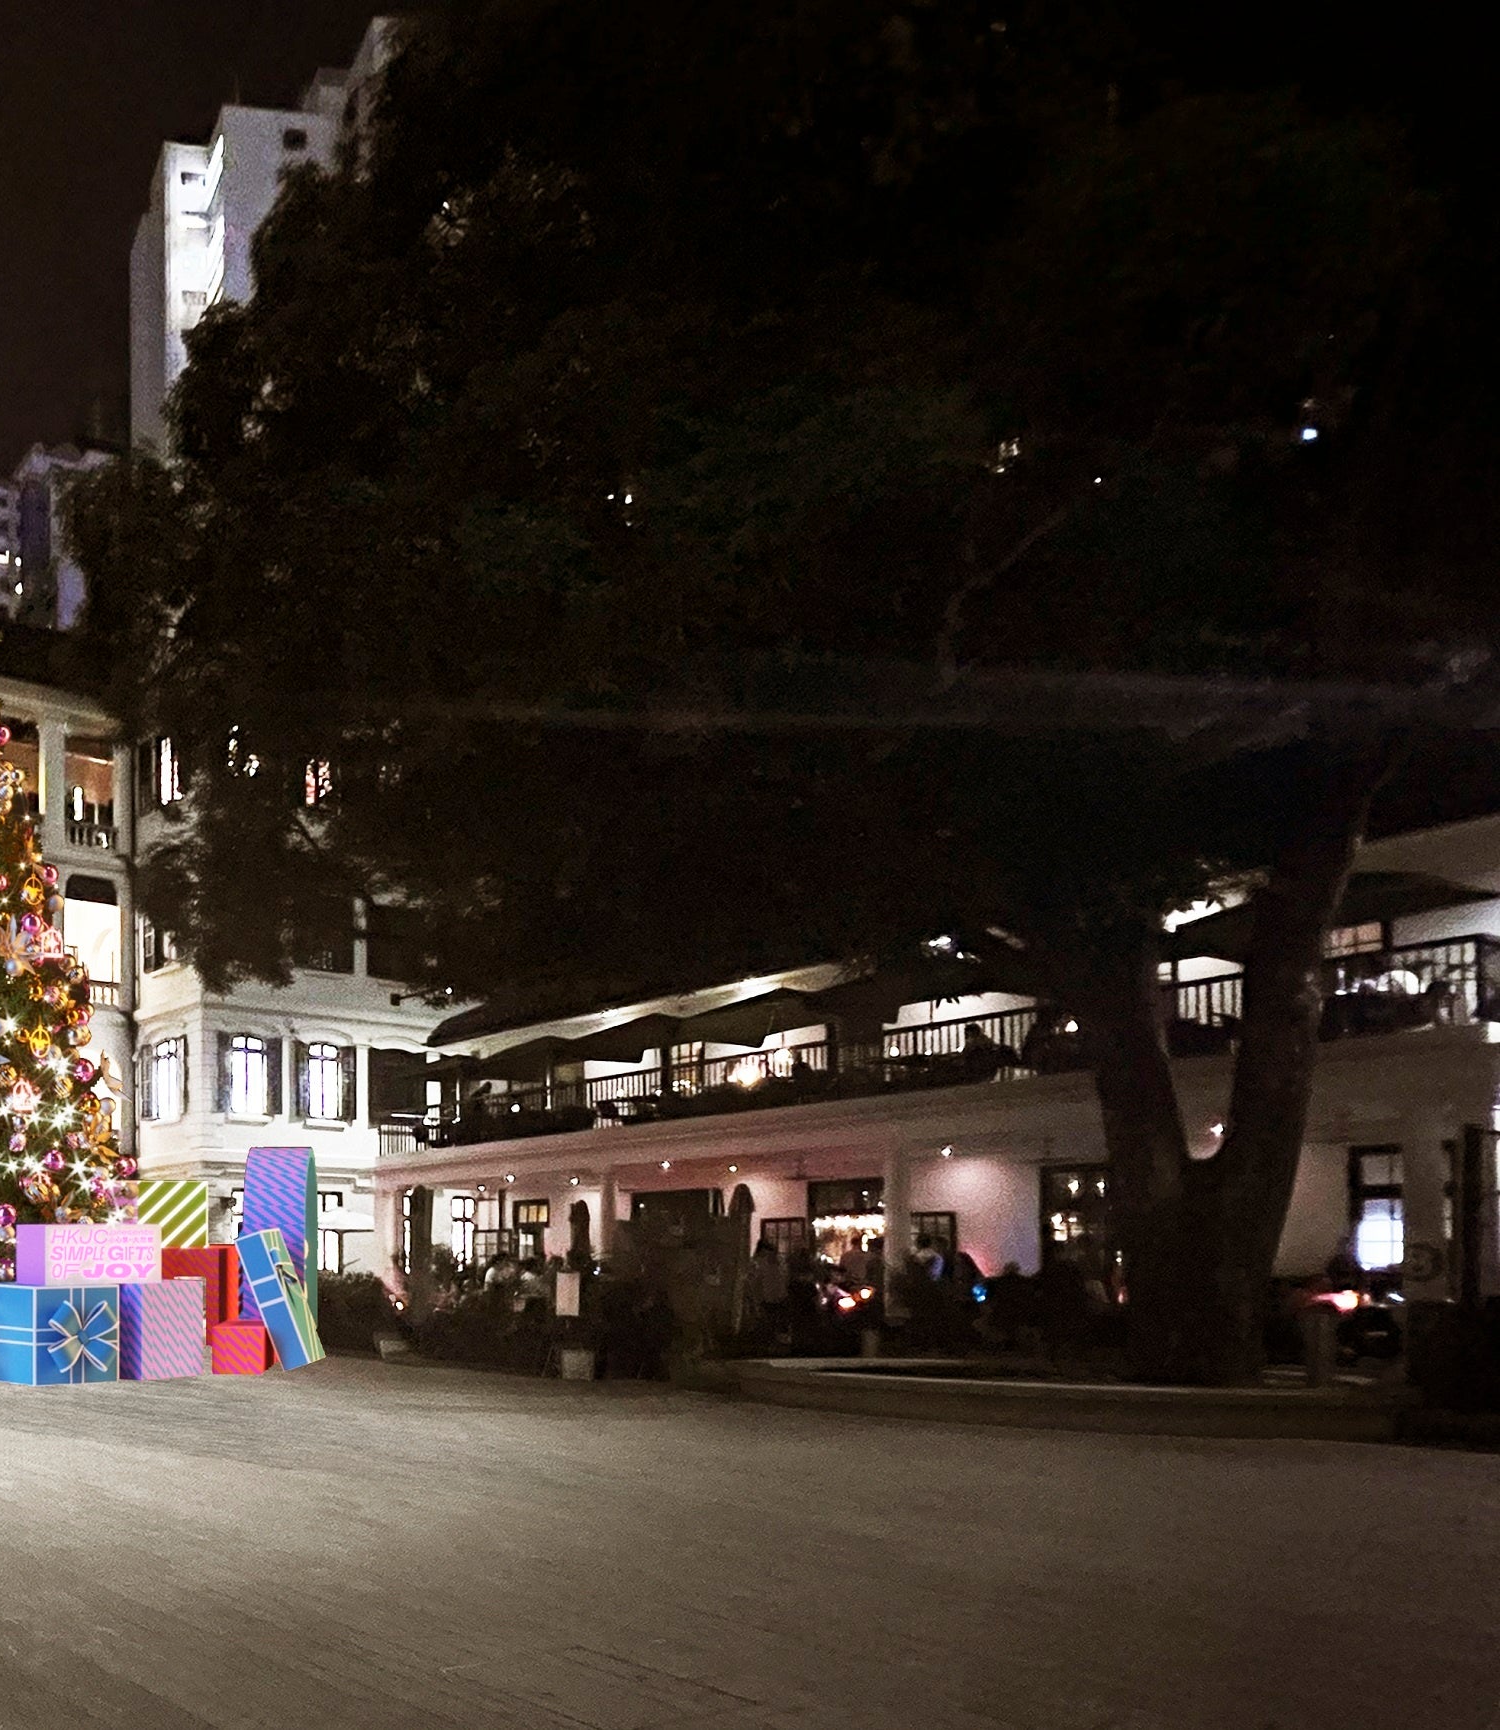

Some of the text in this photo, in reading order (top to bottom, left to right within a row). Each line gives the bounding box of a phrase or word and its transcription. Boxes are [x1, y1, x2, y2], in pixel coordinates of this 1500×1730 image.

[51, 1229, 108, 1244] HKJC
[50, 1246, 155, 1261] SIMPLE GIFTS
[51, 1263, 156, 1279] OF JOY
